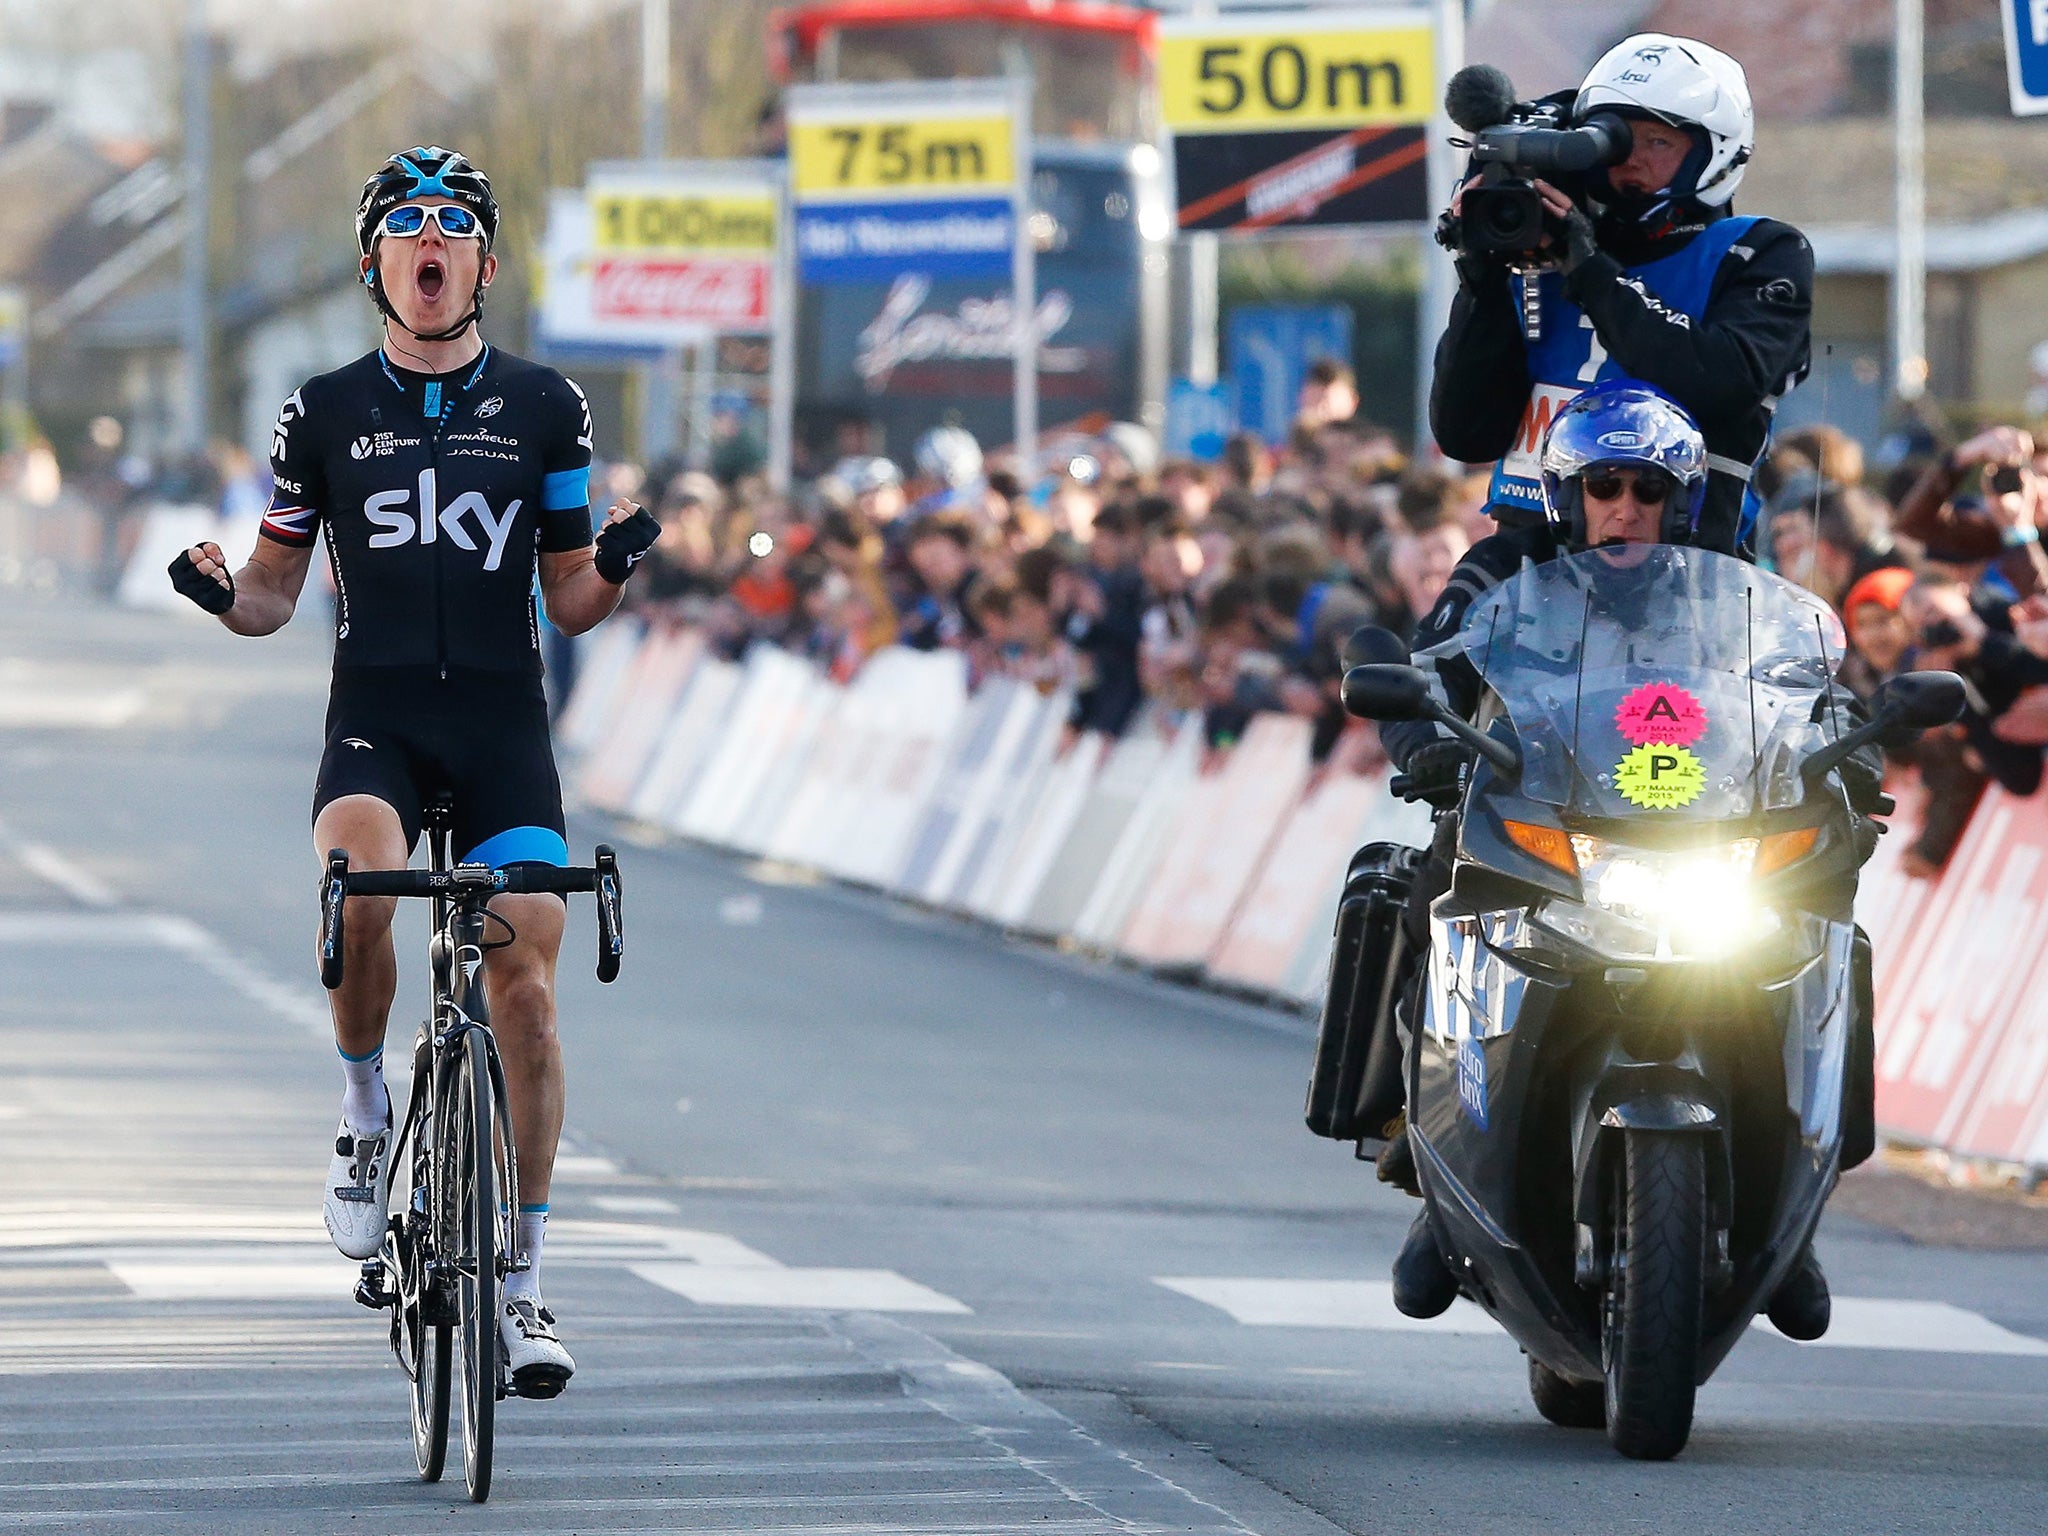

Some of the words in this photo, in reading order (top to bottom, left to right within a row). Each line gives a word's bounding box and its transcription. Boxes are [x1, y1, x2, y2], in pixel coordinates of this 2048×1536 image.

[1199, 43, 1405, 113] 50m
[827, 123, 985, 185] 75m
[373, 432, 395, 442] 21ST
[374, 438, 421, 449] CENTURY
[447, 432, 519, 446] PINARELLO
[375, 447, 395, 457] FOX
[446, 449, 520, 463] JAGUAR
[1644, 696, 1680, 721] A
[1651, 755, 1678, 780] P
[1649, 784, 1686, 793] MAART
[1647, 792, 1673, 800] 2015
